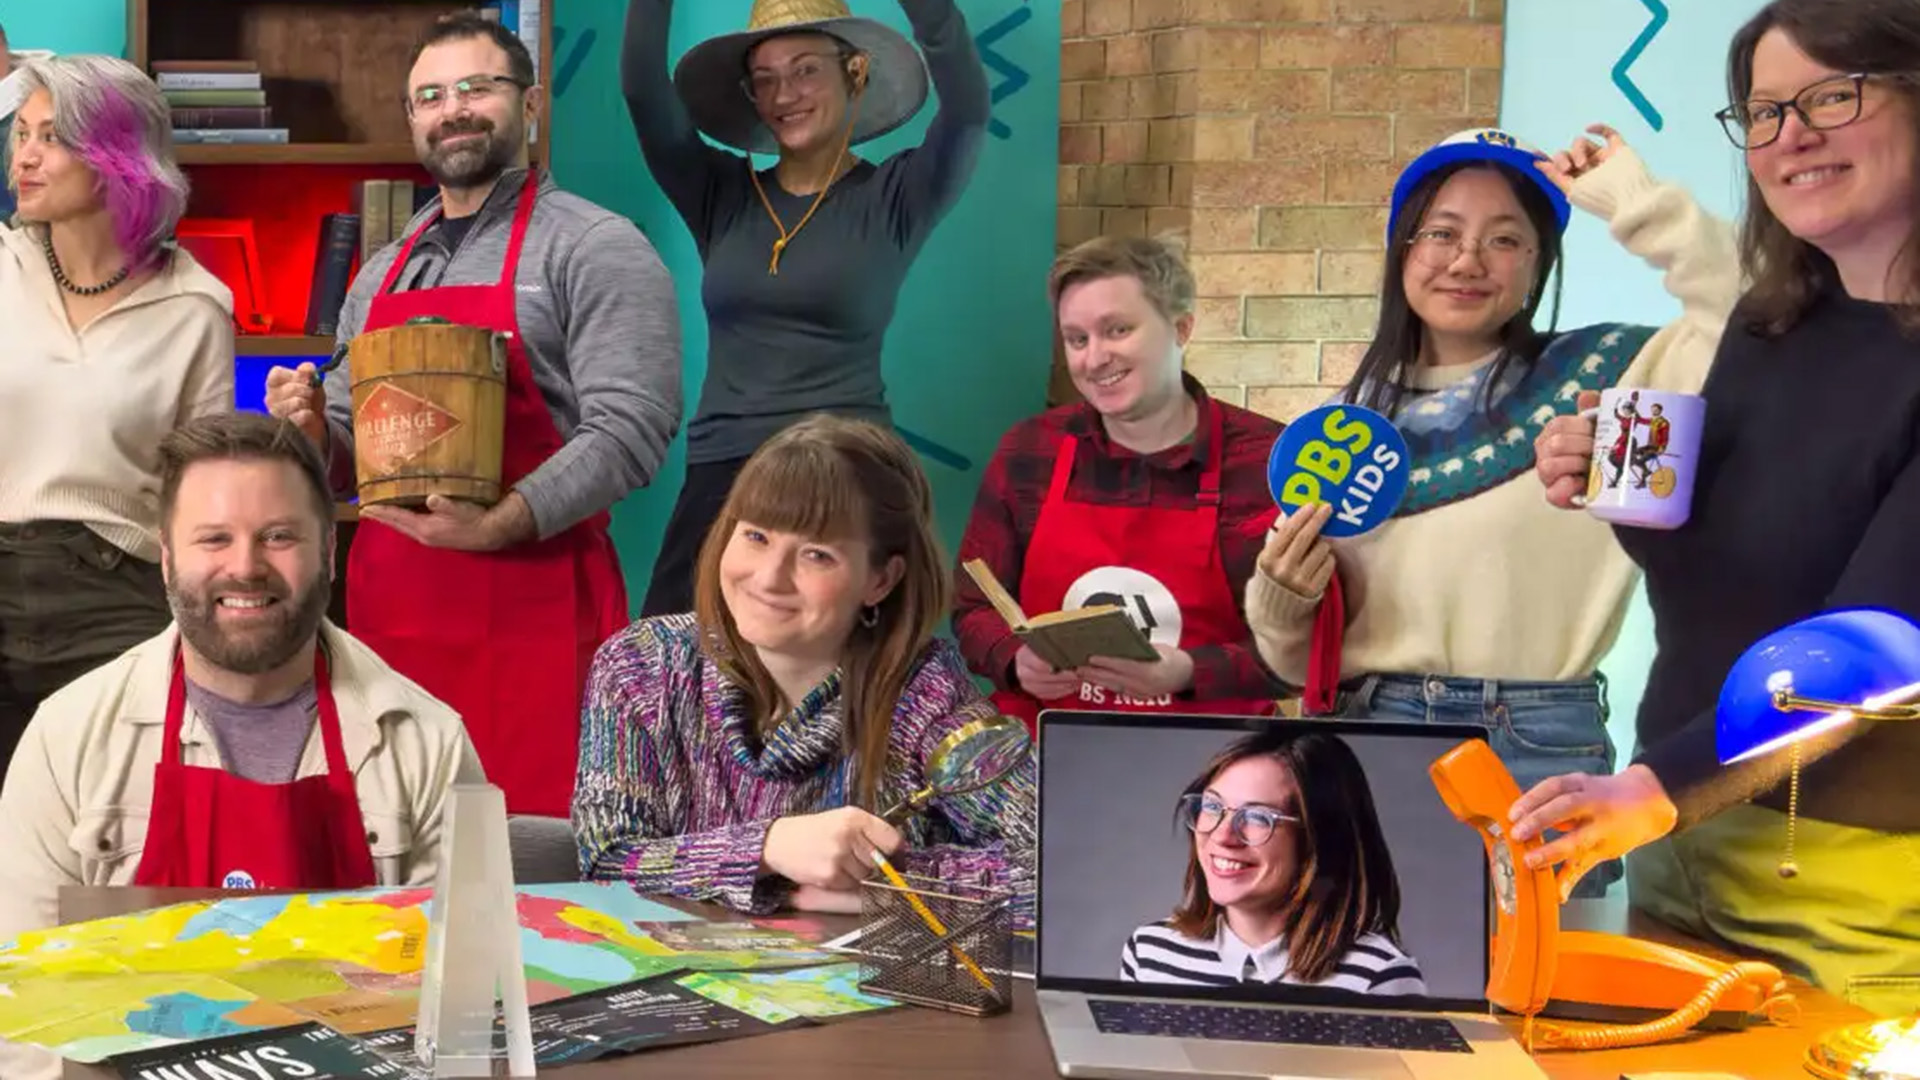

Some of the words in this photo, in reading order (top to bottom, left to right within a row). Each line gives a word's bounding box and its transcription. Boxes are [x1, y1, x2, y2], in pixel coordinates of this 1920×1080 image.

[357, 411, 436, 437] ALLENGE
[1281, 408, 1372, 507] PBS
[1336, 443, 1400, 527] KIDS
[1079, 681, 1106, 705] BS
